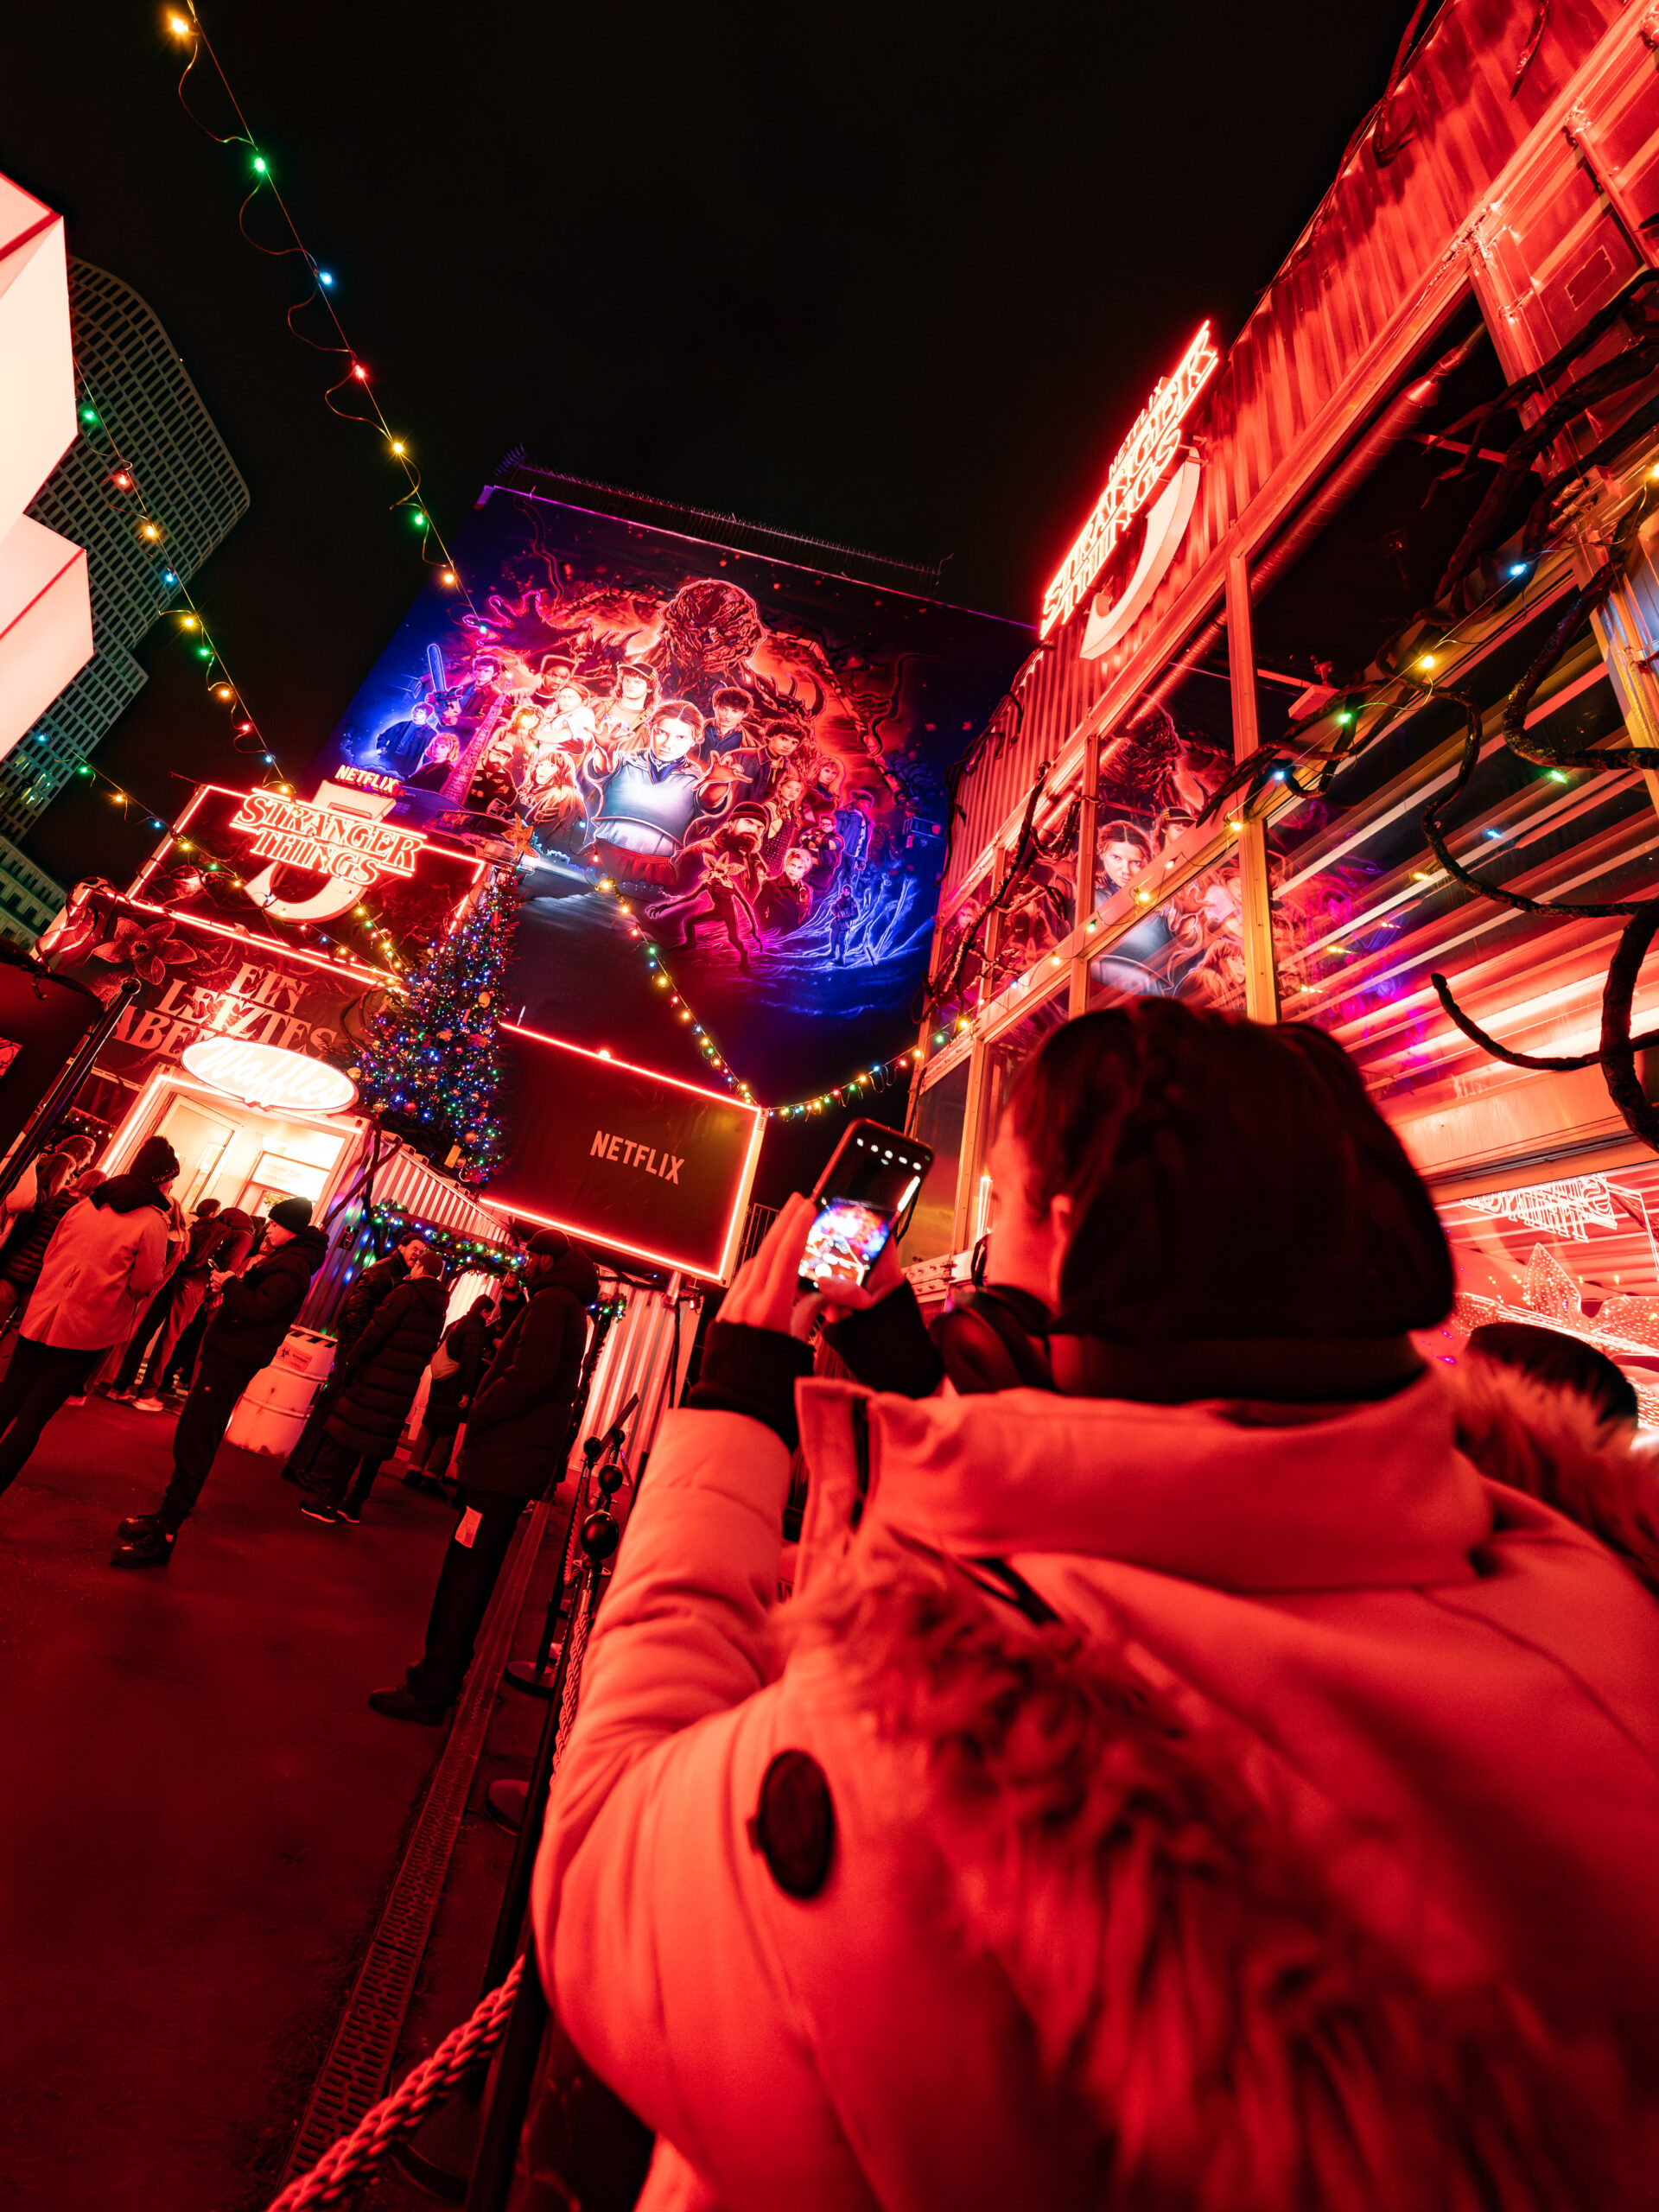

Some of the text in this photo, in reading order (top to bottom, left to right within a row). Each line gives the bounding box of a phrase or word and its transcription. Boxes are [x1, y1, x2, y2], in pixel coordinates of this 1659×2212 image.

[1042, 329, 1217, 622] STRANGER
[1062, 429, 1182, 625] THINGS
[334, 765, 400, 794] NETFLIX
[232, 793, 423, 872] STRANGER
[250, 827, 380, 886] THINGS
[154, 978, 338, 1059] LETZTES
[226, 961, 310, 1014] EIN
[197, 1042, 344, 1105] Waffles
[589, 1129, 685, 1185] NETFLIX
